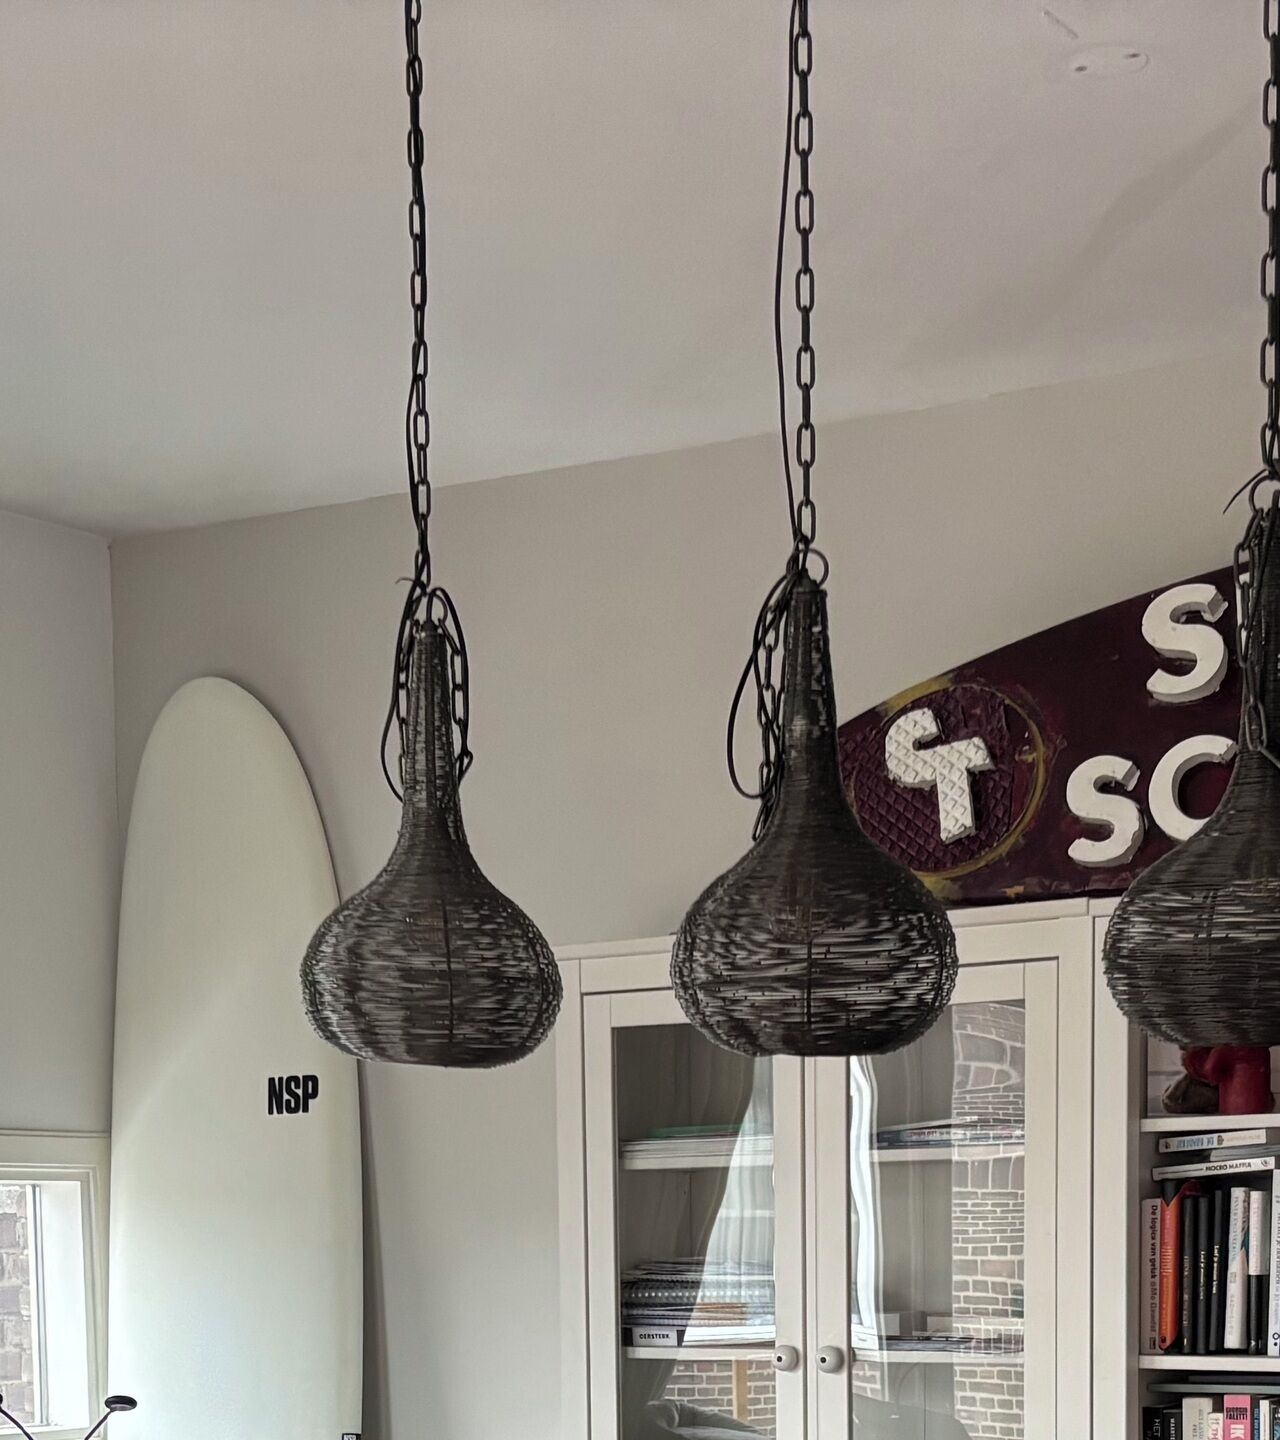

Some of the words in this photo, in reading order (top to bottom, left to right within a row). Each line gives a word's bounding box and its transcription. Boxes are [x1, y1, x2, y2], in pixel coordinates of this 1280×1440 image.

[268, 1075, 318, 1115] NSP
[1150, 1205, 1157, 1216] De
[1149, 1217, 1158, 1240] logica
[1149, 1259, 1158, 1279] geluk
[1230, 1424, 1244, 1439] IK
